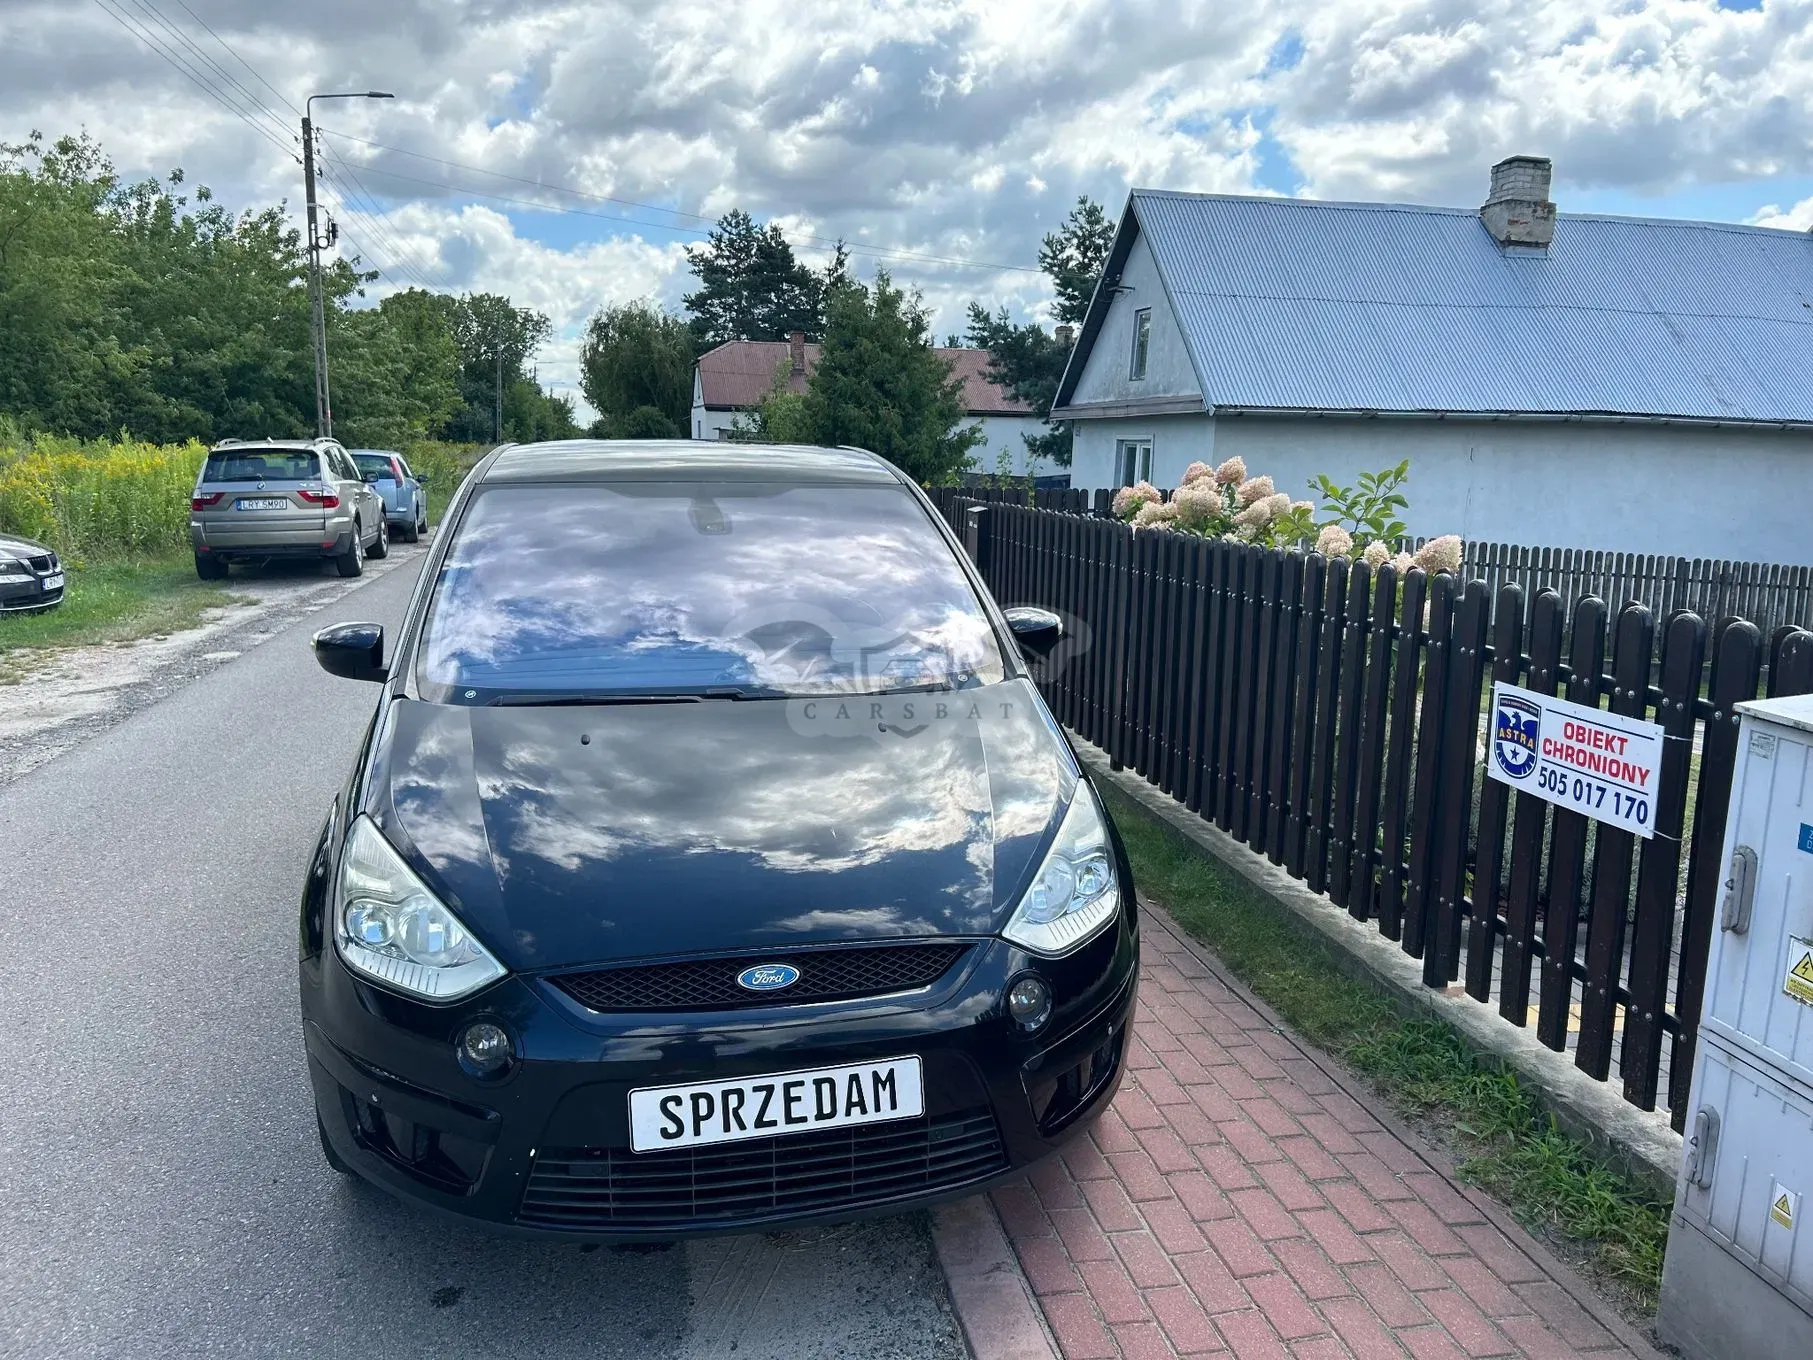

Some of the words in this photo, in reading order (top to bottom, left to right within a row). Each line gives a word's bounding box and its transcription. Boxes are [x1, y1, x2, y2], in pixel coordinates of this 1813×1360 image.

[242, 500, 259, 510] LRY
[1499, 728, 1534, 749] ASTRA
[1563, 721, 1628, 756] OBIEKT
[1542, 738, 1651, 787] CHRONIONY
[1538, 766, 1568, 796] 505
[1573, 778, 1607, 808] 017
[1614, 791, 1649, 825] 170
[752, 969, 785, 985] Ford
[659, 1067, 898, 1140] SPRZEDAM
